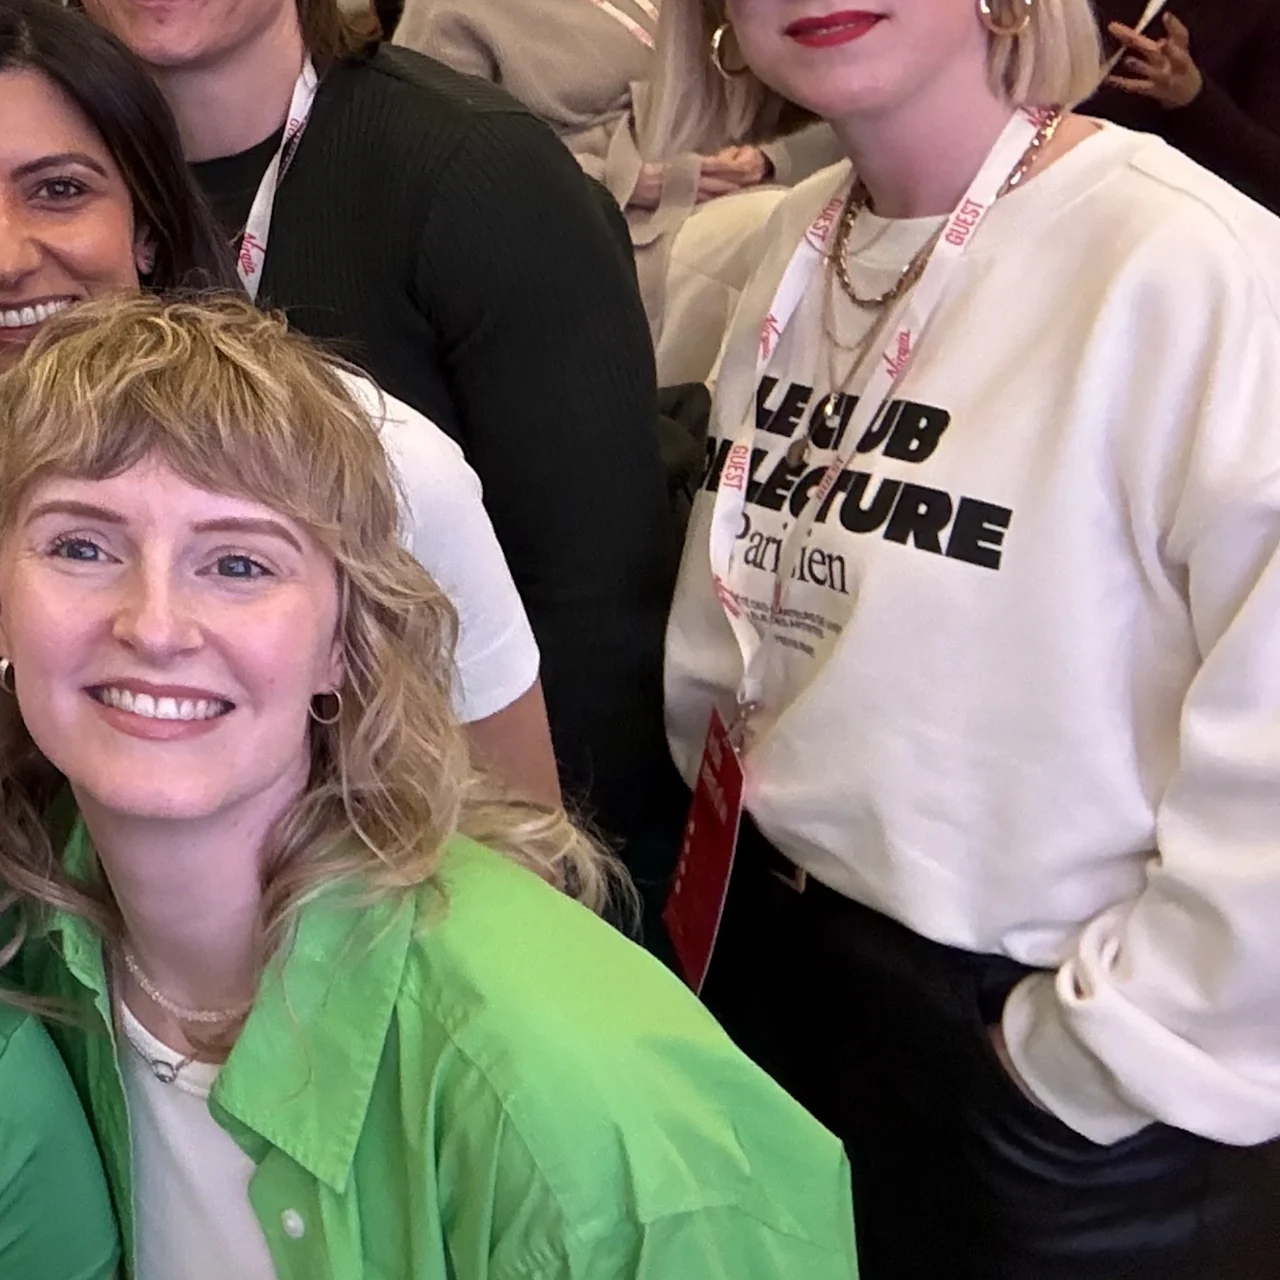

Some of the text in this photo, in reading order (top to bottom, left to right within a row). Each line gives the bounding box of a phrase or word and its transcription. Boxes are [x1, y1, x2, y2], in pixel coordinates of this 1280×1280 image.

[808, 197, 844, 243] GUEST
[945, 197, 986, 247] GUEST
[239, 231, 268, 277] Virgin
[882, 328, 911, 380] Virgin
[755, 374, 814, 438] LE
[722, 444, 749, 491] GUEST
[735, 511, 849, 595] ariien
